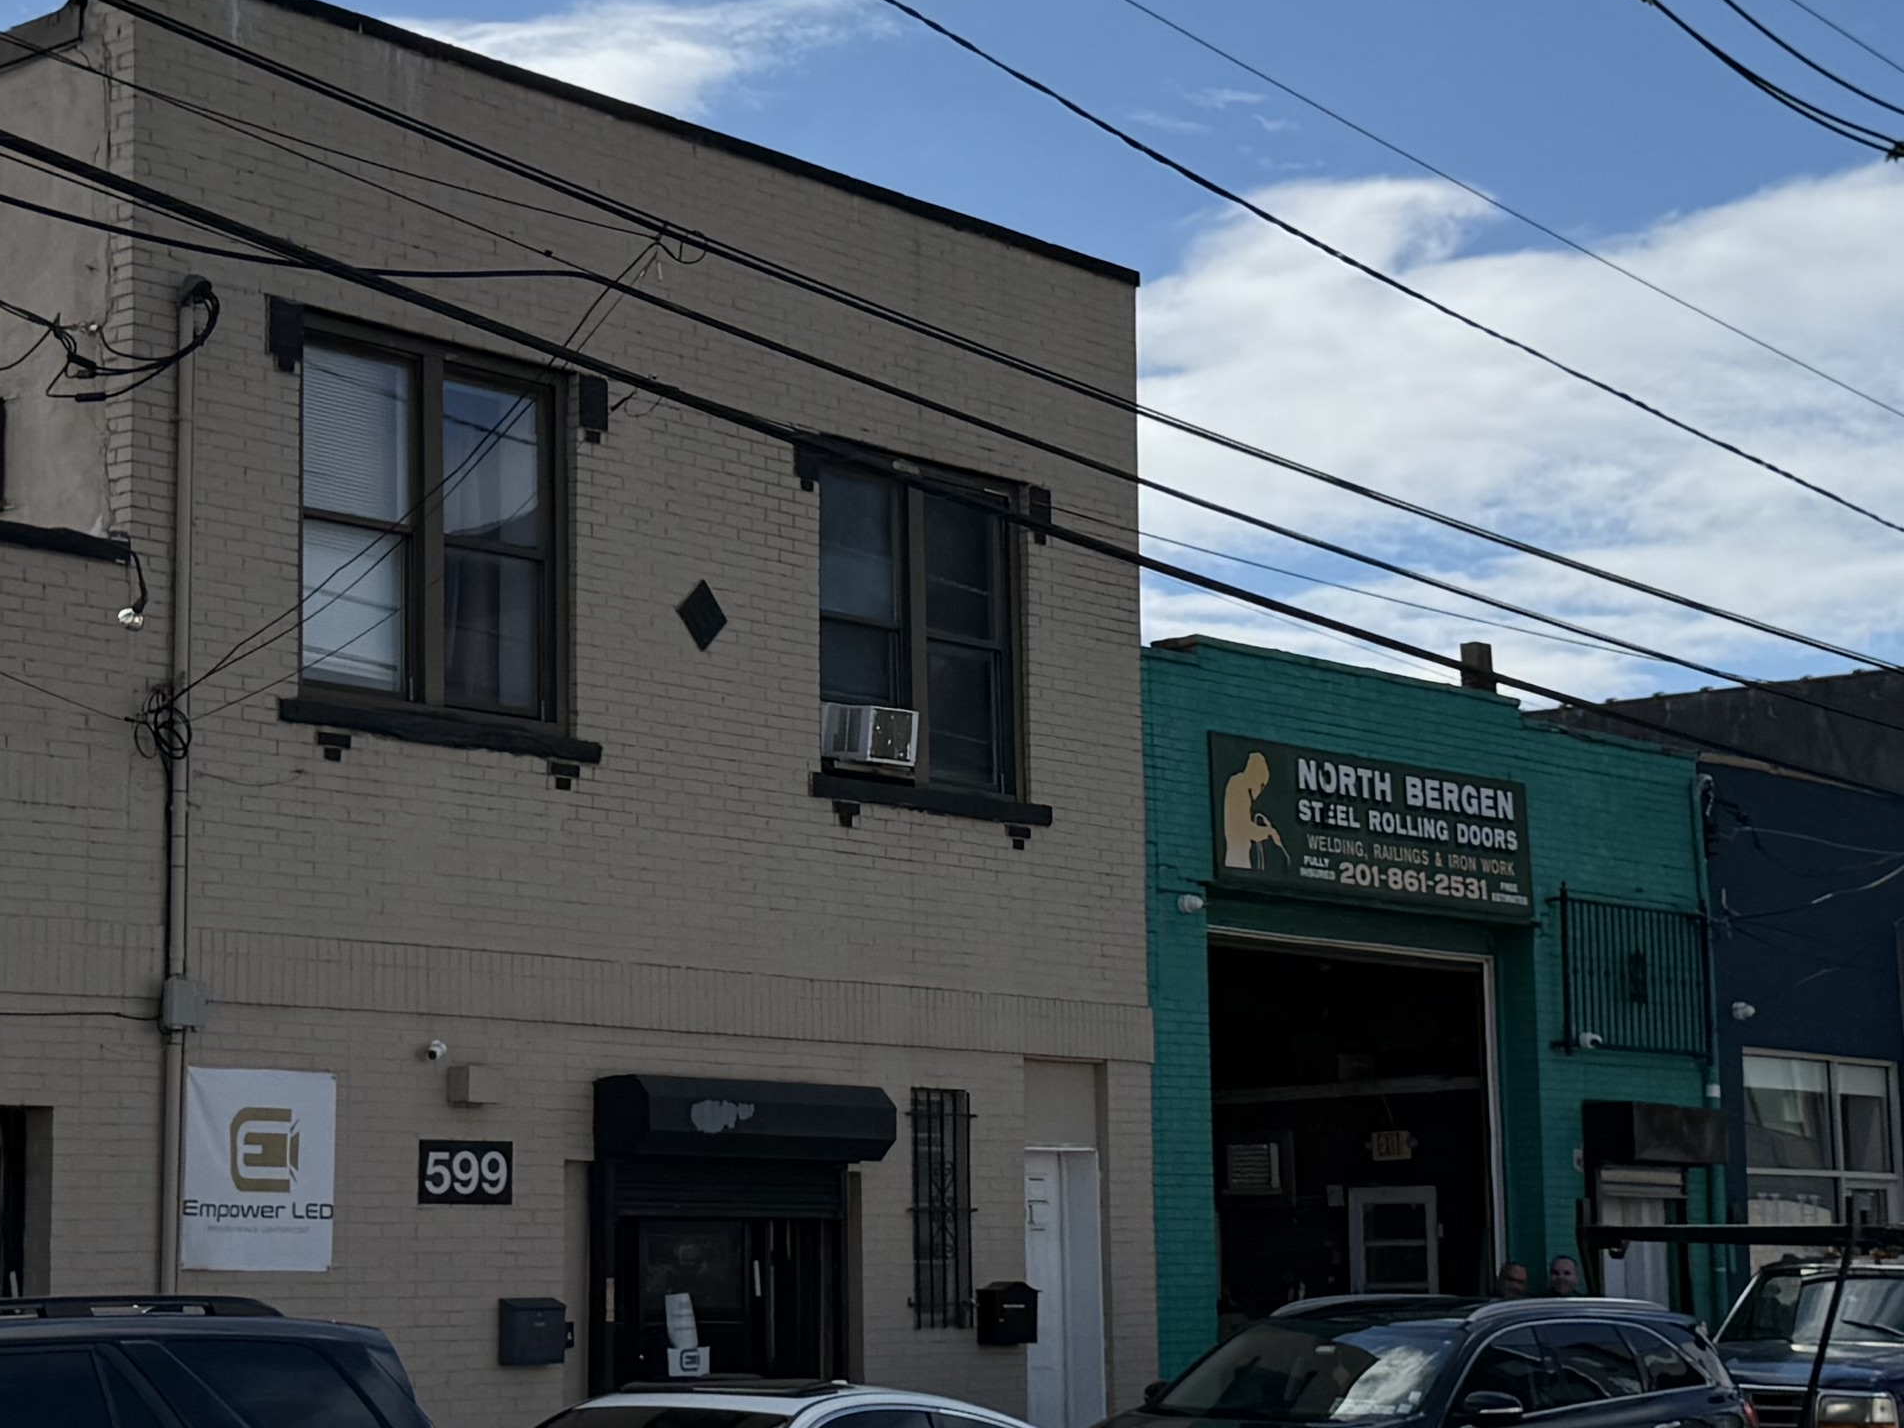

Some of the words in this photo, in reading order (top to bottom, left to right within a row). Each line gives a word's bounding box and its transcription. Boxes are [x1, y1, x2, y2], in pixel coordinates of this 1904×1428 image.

[1297, 758, 1392, 803] NORTH
[1405, 775, 1515, 821] BERGEN
[1298, 799, 1361, 829] STEEL
[1368, 810, 1449, 841] ROLLING
[1456, 822, 1519, 851] DOORS
[1306, 834, 1368, 860] WELDING,
[1373, 844, 1429, 867] RAILINGS
[1435, 851, 1443, 868] &
[1447, 853, 1477, 872] IRON
[1481, 858, 1515, 876] WORK
[1338, 861, 1488, 901] 201-861-2531
[424, 1150, 508, 1195] 599
[182, 1199, 286, 1223] Empower
[292, 1202, 334, 1220] LED
